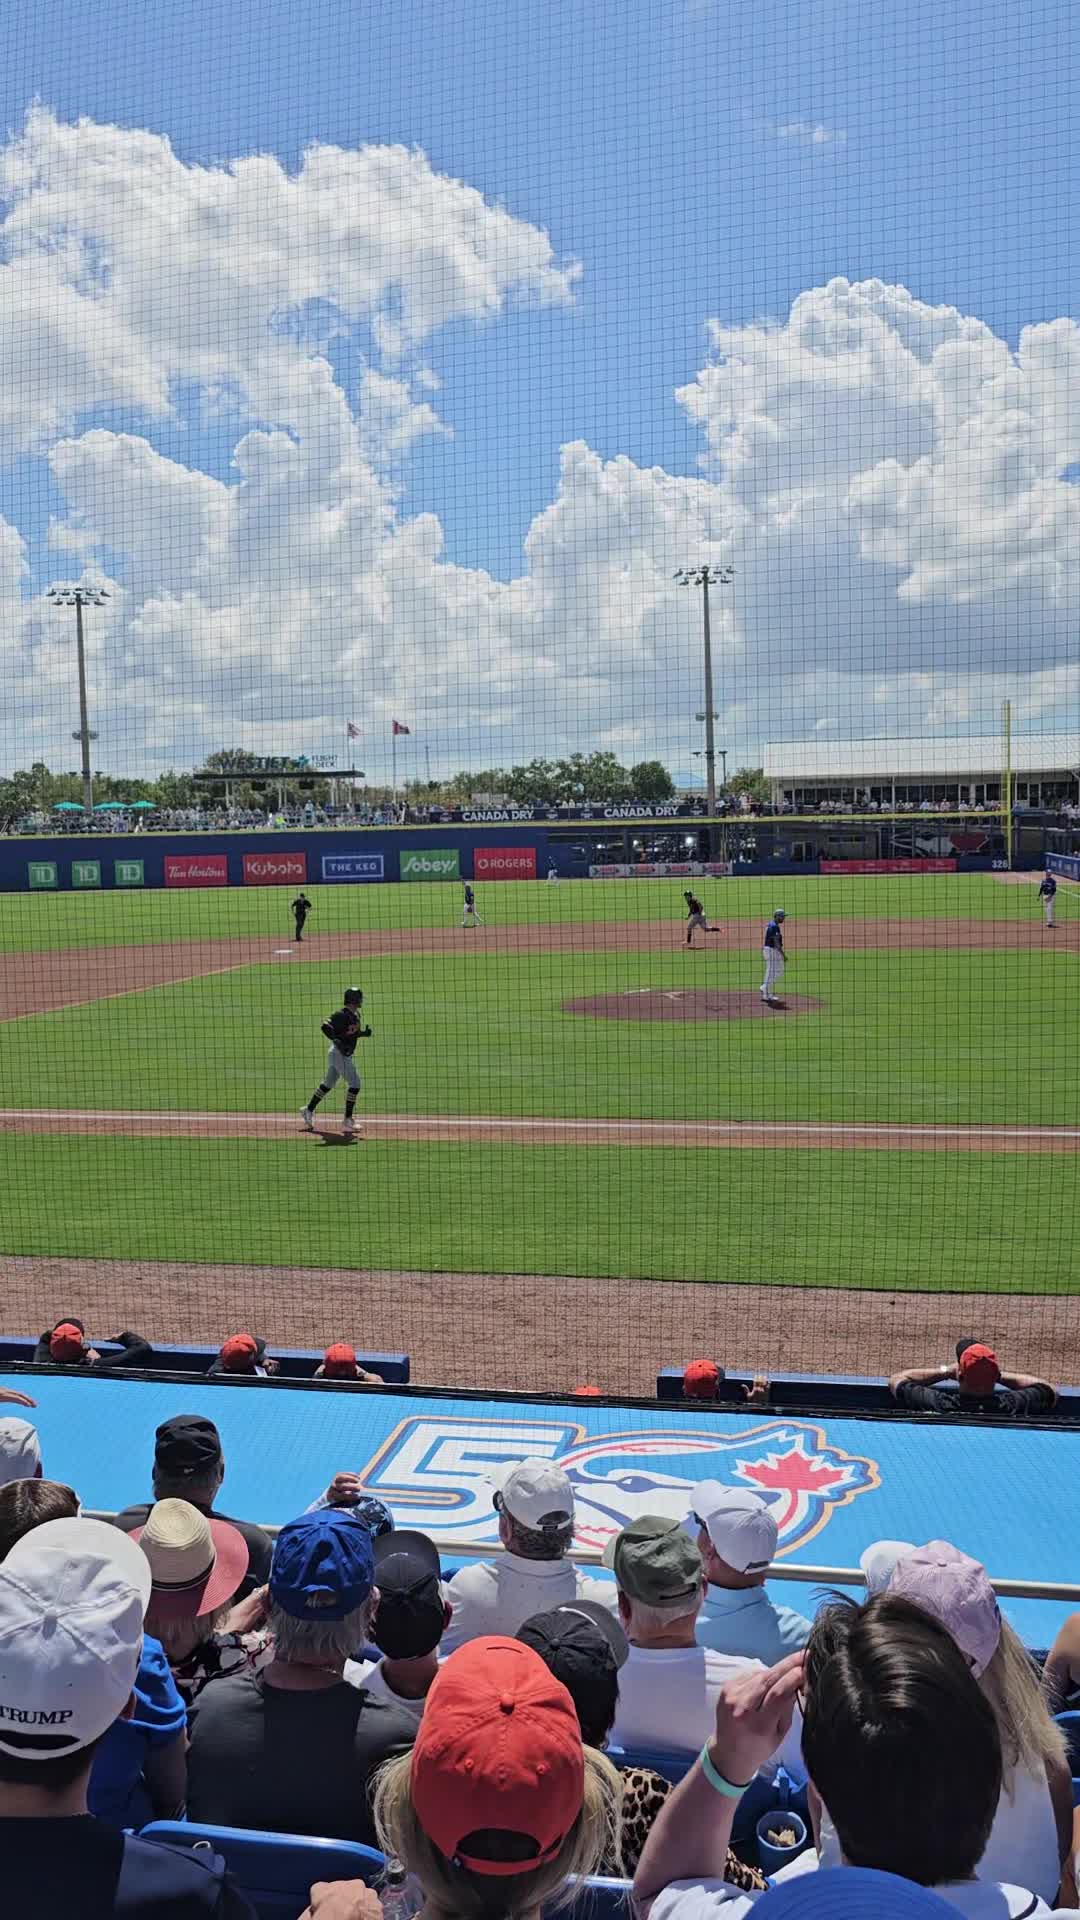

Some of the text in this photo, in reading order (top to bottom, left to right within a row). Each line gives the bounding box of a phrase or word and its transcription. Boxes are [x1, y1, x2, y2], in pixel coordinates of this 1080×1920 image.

[462, 811, 510, 821] CANADA
[604, 807, 653, 817] CANADA
[246, 861, 303, 875] Kubota
[330, 861, 377, 871] THE KEG
[403, 856, 457, 874] Sobeys
[490, 858, 533, 869] ROGERS
[32, 866, 55, 882] TD
[74, 865, 98, 881] TD
[117, 864, 140, 880] TD
[168, 864, 225, 878] Tim Hortons
[0, 1705, 73, 1725] TRUMP
